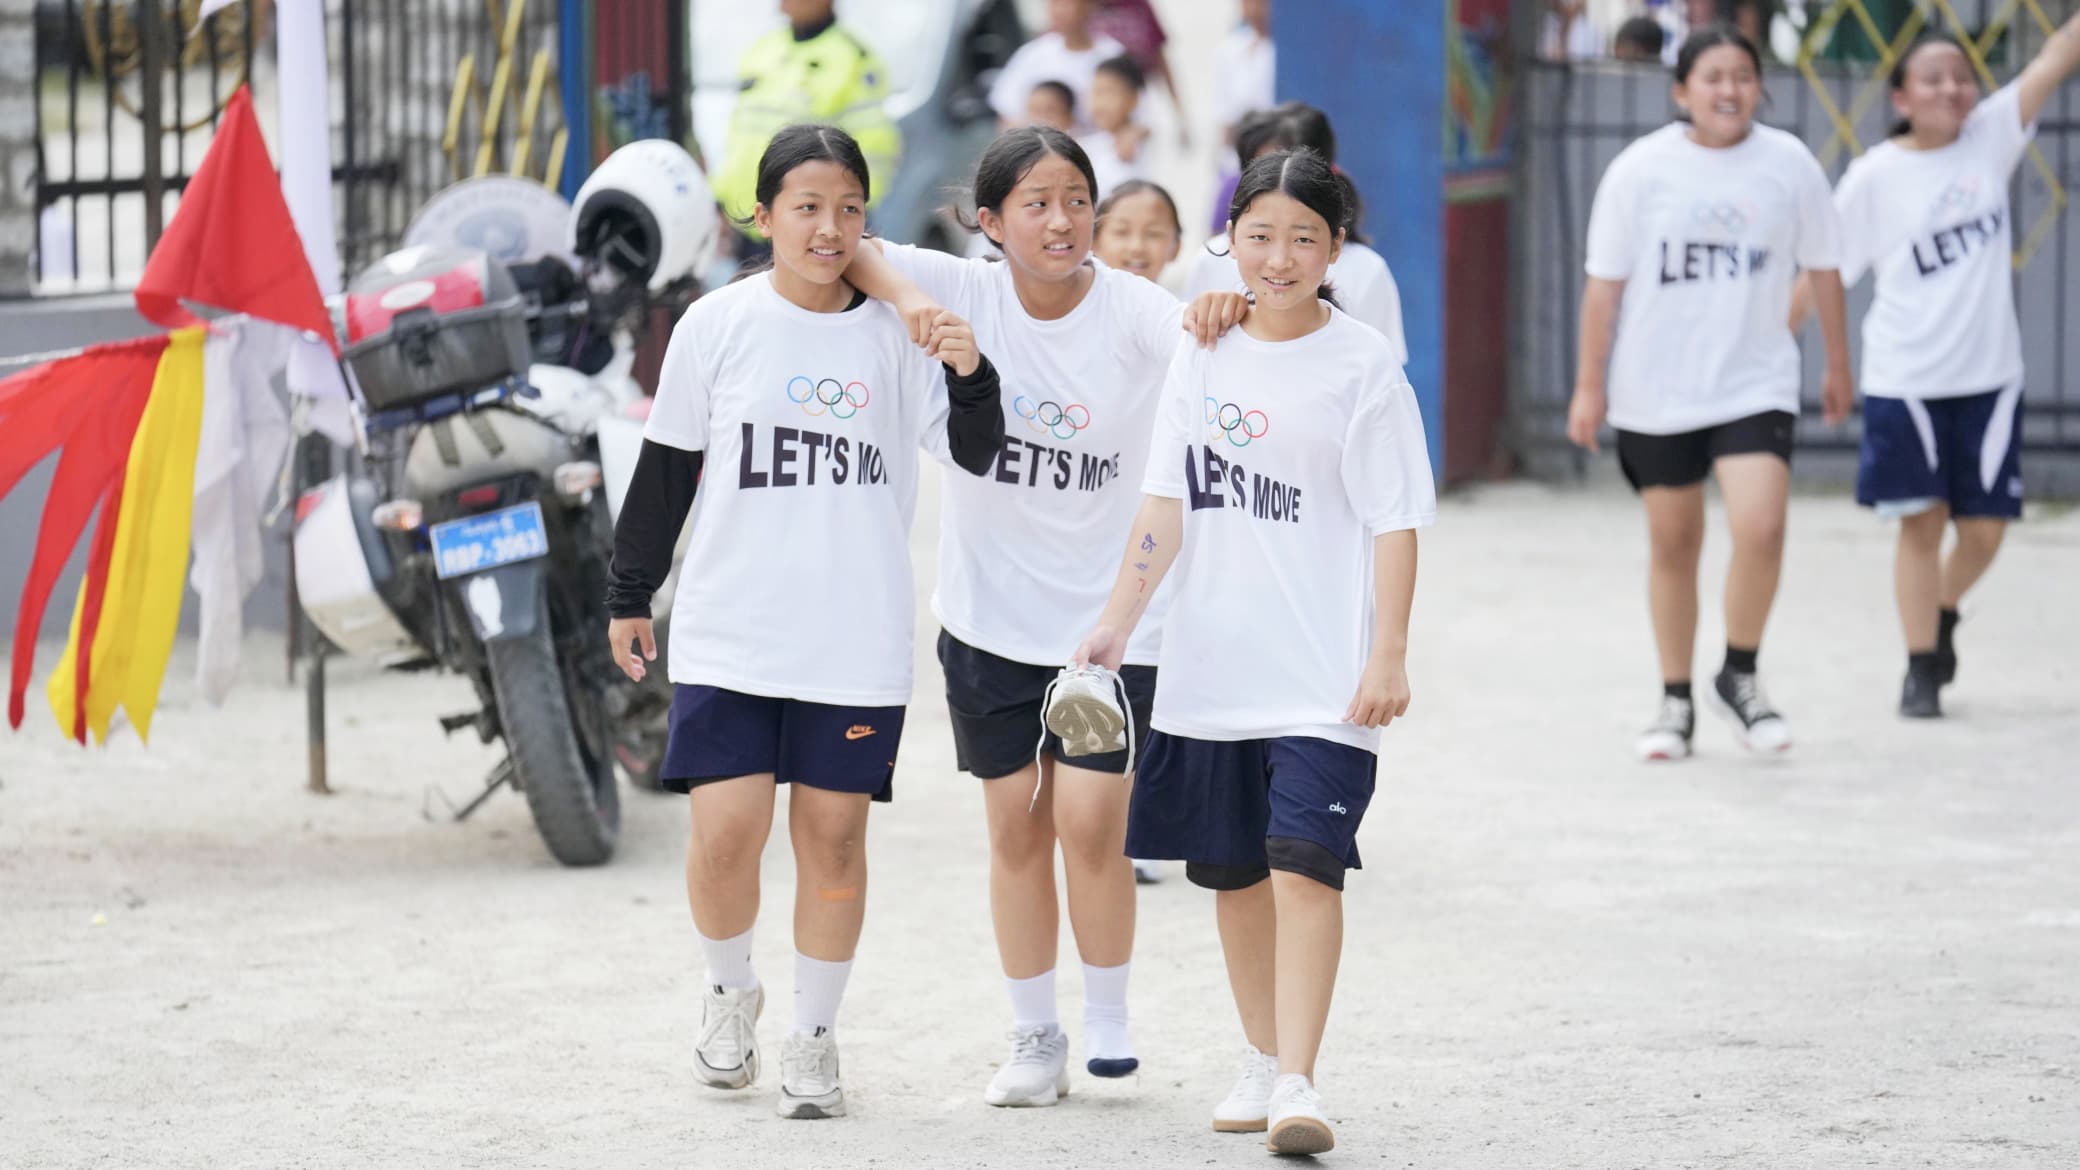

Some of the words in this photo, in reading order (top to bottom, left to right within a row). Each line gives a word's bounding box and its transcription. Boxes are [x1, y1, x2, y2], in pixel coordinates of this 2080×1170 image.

[739, 422, 850, 490] LET'S
[857, 441, 888, 486] MO
[995, 434, 1073, 491] ET'S
[1078, 451, 1120, 492] MOE
[1253, 472, 1302, 524] MOVE
[1328, 801, 1347, 815] alo
